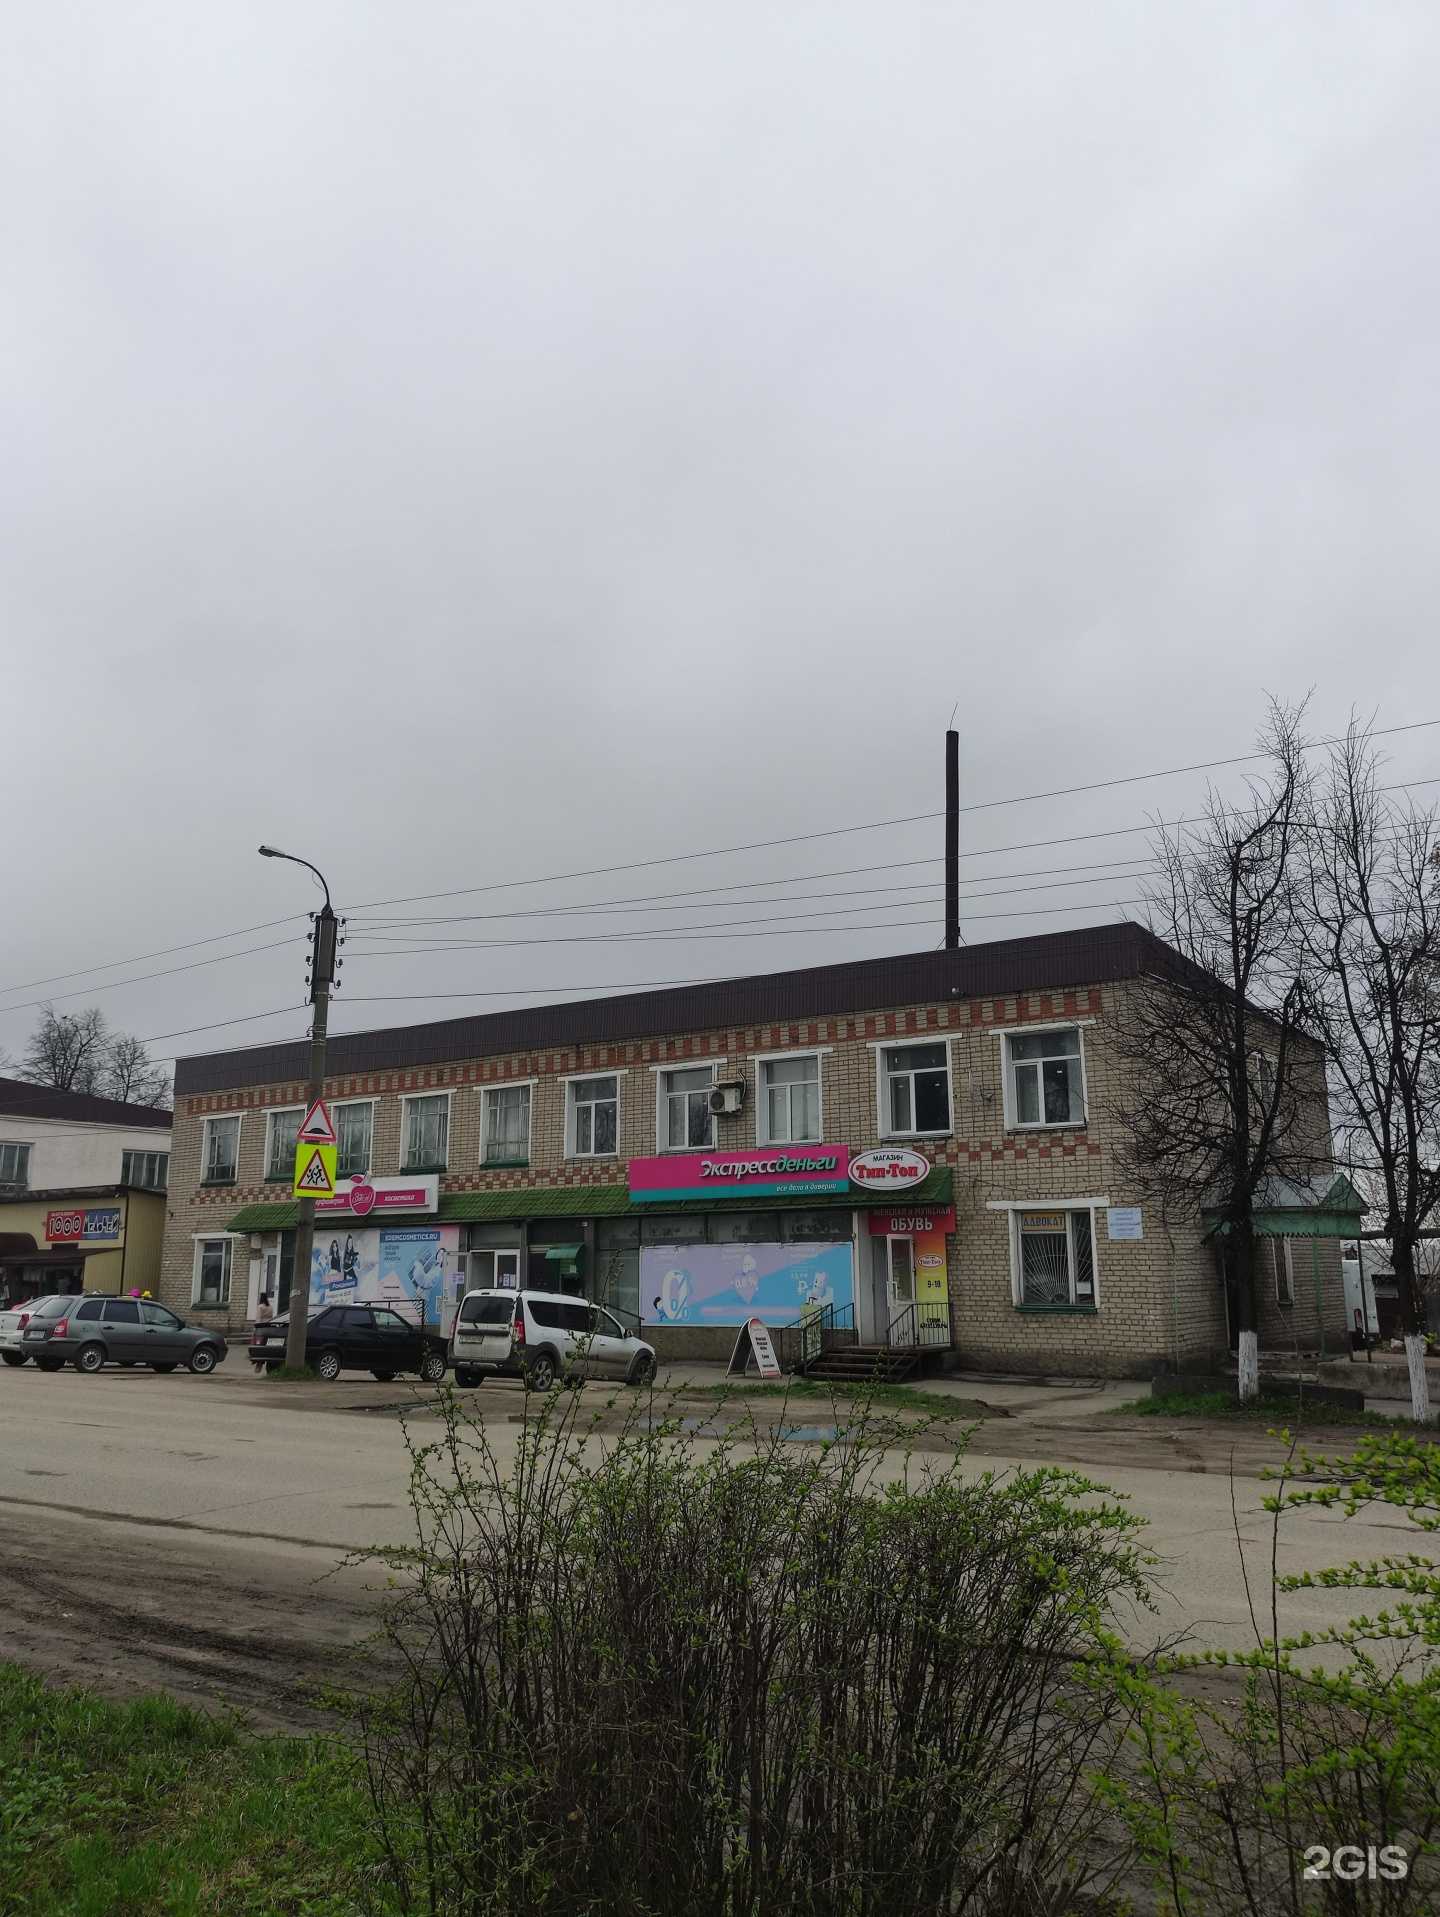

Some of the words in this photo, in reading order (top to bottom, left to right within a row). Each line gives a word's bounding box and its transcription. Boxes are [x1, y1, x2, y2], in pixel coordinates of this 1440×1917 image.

[873, 1154, 903, 1162] МАГАЗИН
[699, 1155, 837, 1179] Экспрессденьги
[856, 1162, 919, 1179] Тип-Топ
[776, 1184, 788, 1192] все
[49, 1215, 82, 1237] 1000
[890, 1217, 933, 1231] ОБУВЬ
[1024, 1215, 1064, 1226] АДВОКАТ
